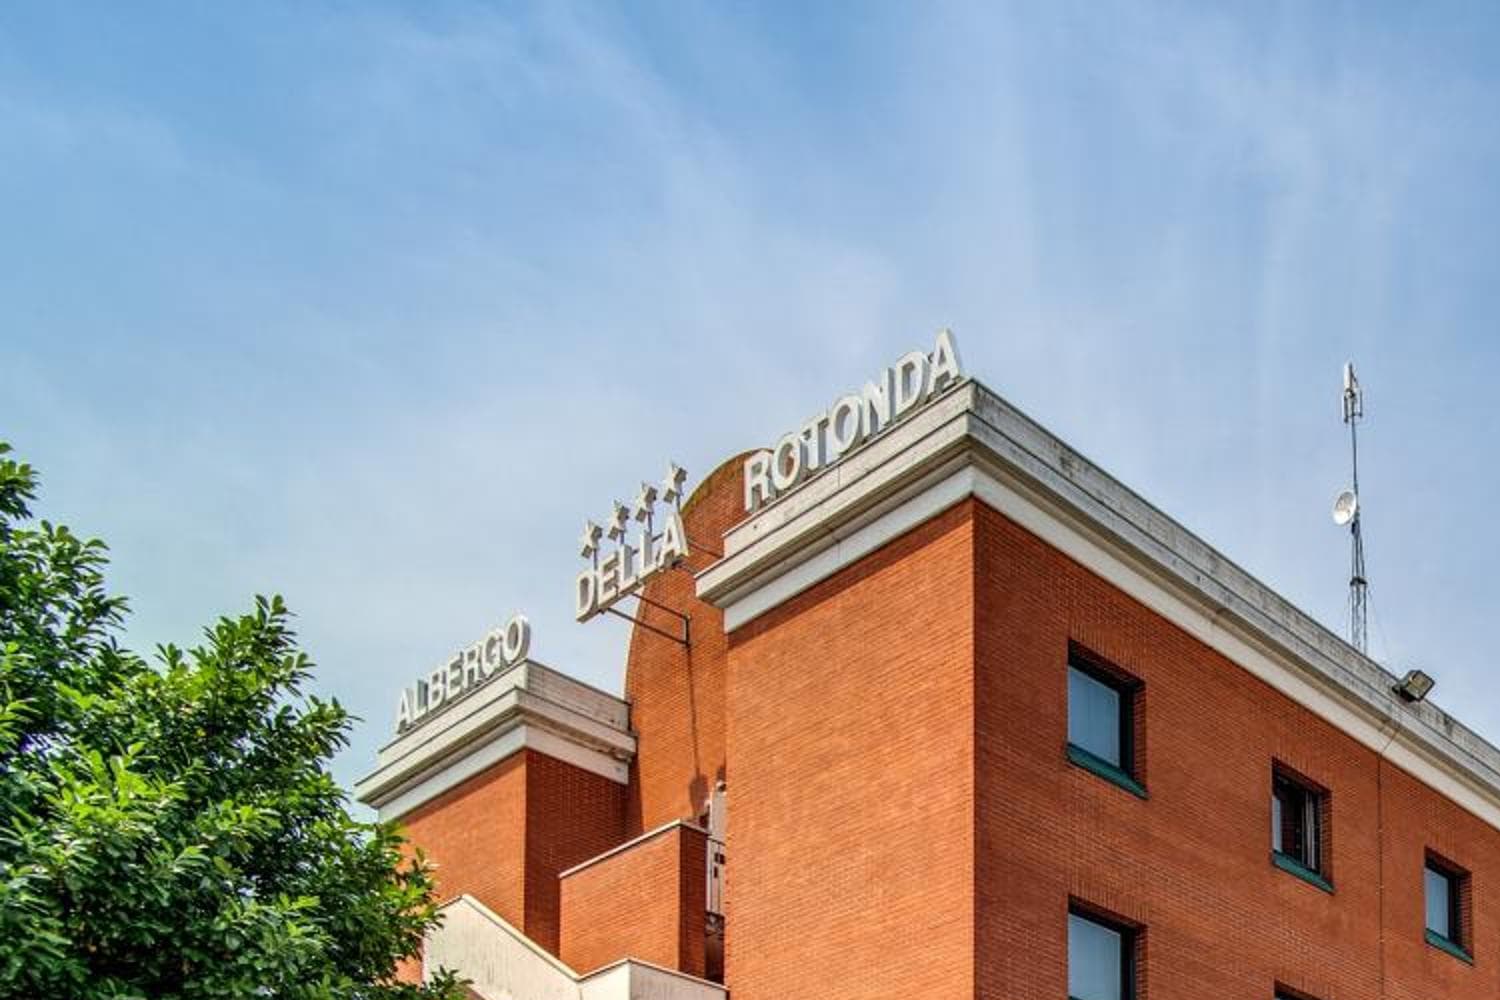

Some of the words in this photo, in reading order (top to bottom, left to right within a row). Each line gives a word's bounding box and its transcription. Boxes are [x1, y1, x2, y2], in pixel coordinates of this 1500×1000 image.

[394, 614, 532, 735] ALBERGO
[575, 513, 689, 624] DELLA
[743, 328, 964, 511] ROTONDA
